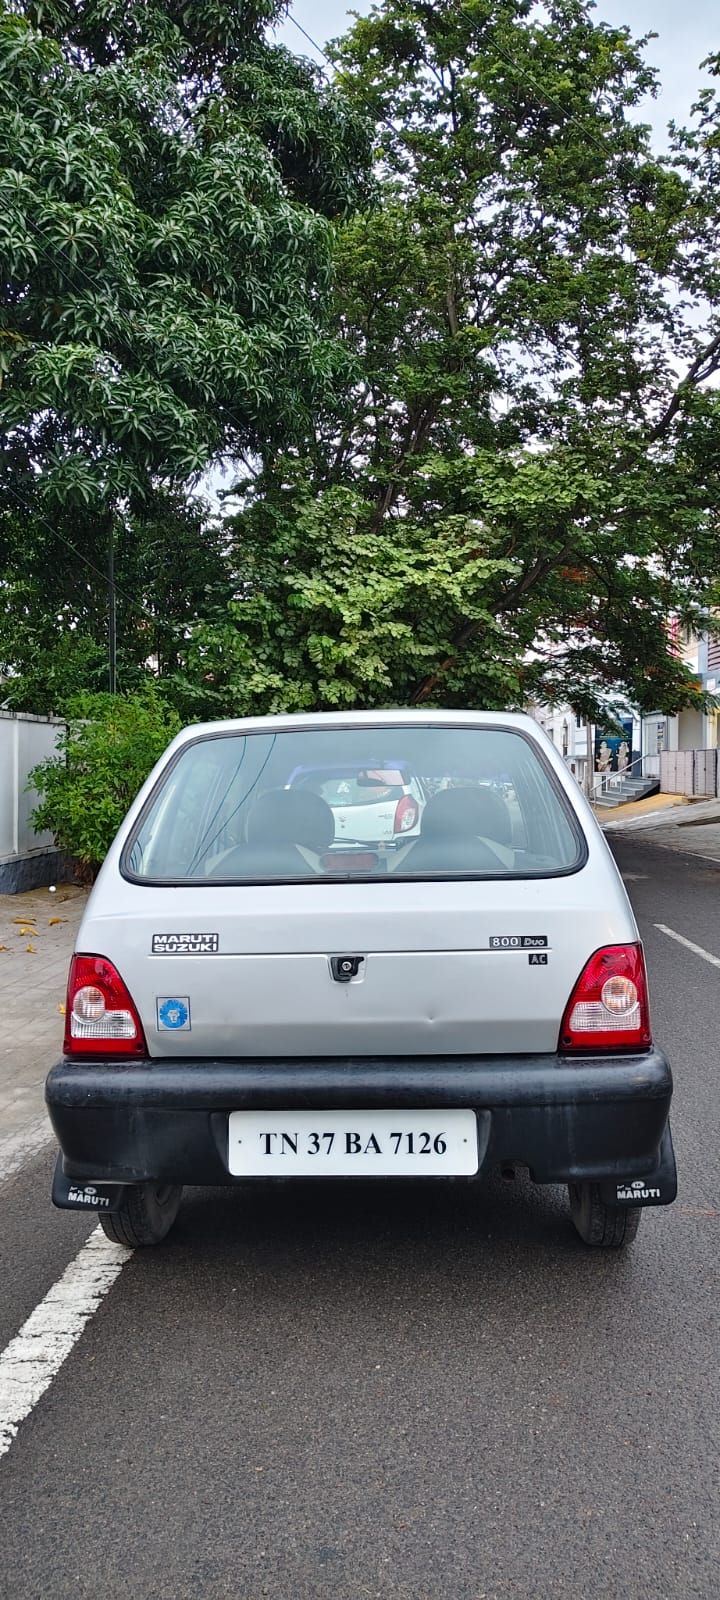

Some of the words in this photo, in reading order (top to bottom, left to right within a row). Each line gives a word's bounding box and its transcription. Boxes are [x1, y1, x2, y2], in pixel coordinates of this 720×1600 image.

[153, 934, 218, 943] MARUTI
[492, 937, 519, 947] 800
[153, 943, 218, 952] SUZUKI
[531, 954, 546, 964] AC
[259, 1132, 300, 1155] TN
[307, 1132, 336, 1155] 37
[343, 1131, 383, 1155] BA
[389, 1131, 447, 1155] 7126
[67, 1191, 110, 1207] MARUTI
[616, 1188, 661, 1200] MARUTI
